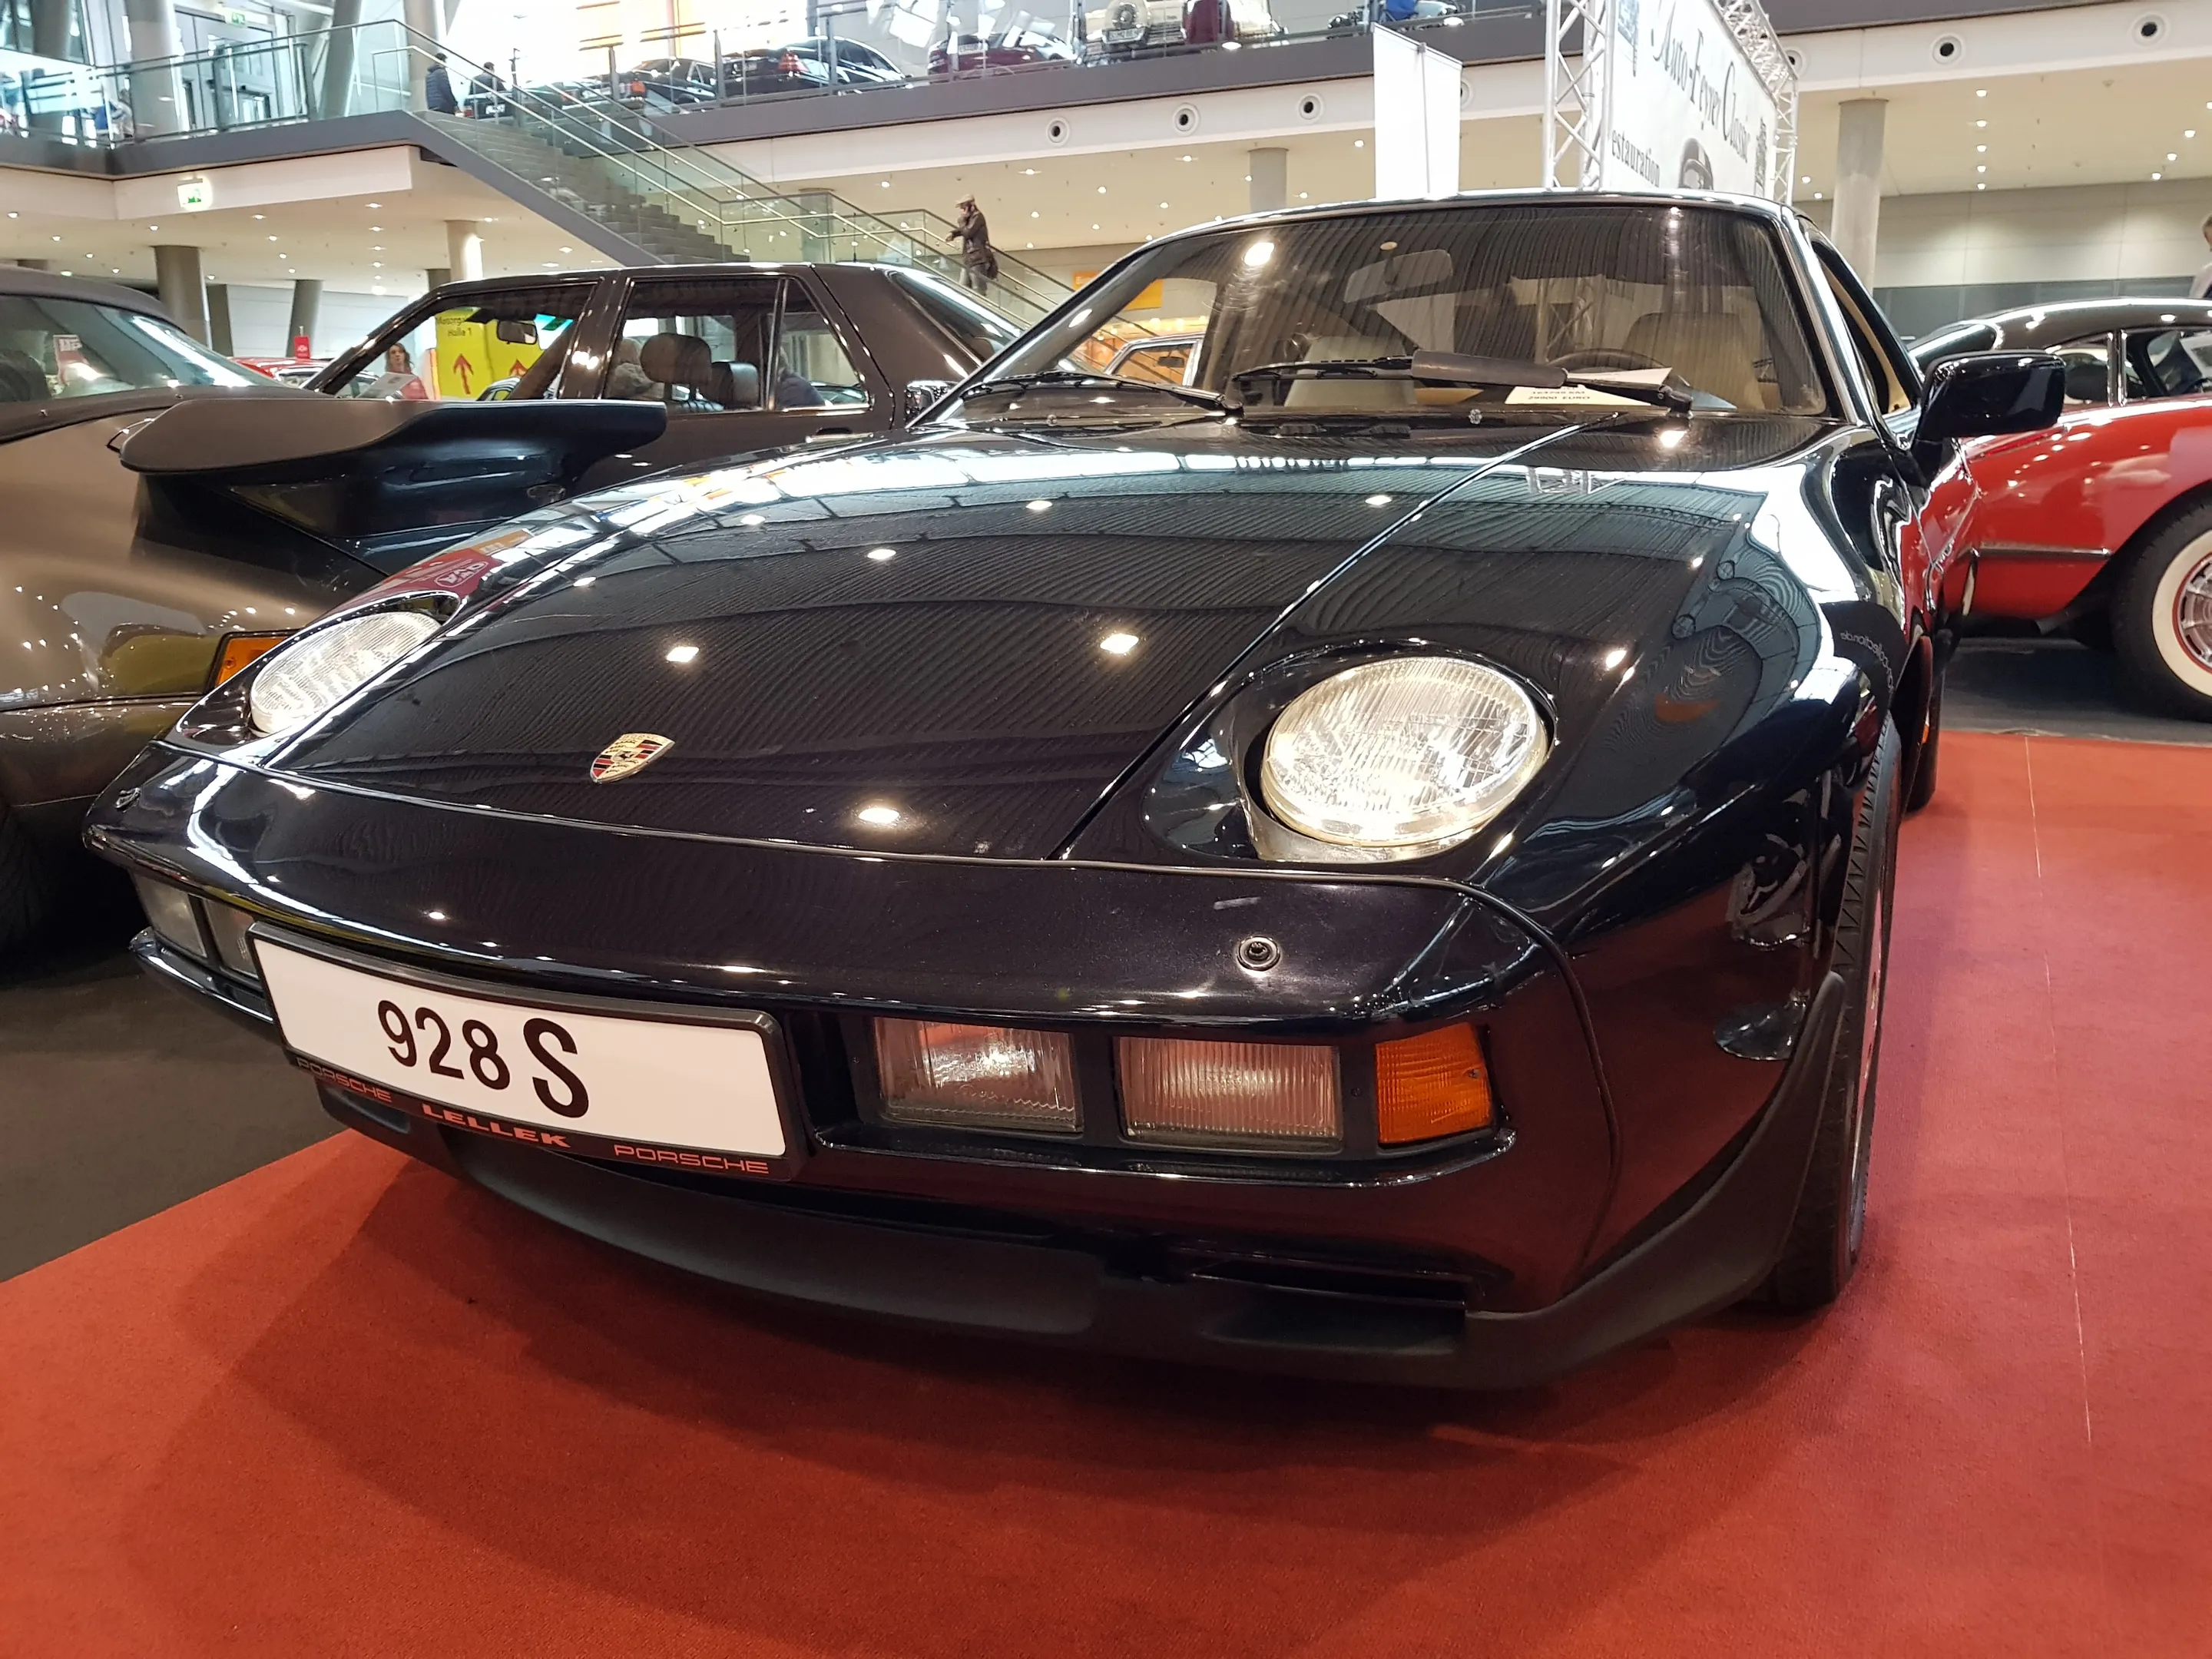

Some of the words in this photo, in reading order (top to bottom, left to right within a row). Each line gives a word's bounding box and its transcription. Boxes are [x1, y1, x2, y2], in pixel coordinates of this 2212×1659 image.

[1611, 130, 1660, 188] estauration
[296, 1057, 392, 1103] PORSCHE
[422, 1104, 571, 1148] LELLEK
[614, 1144, 770, 1174] PORSCHE
[378, 1000, 510, 1090] 928
[523, 1018, 588, 1118] S
